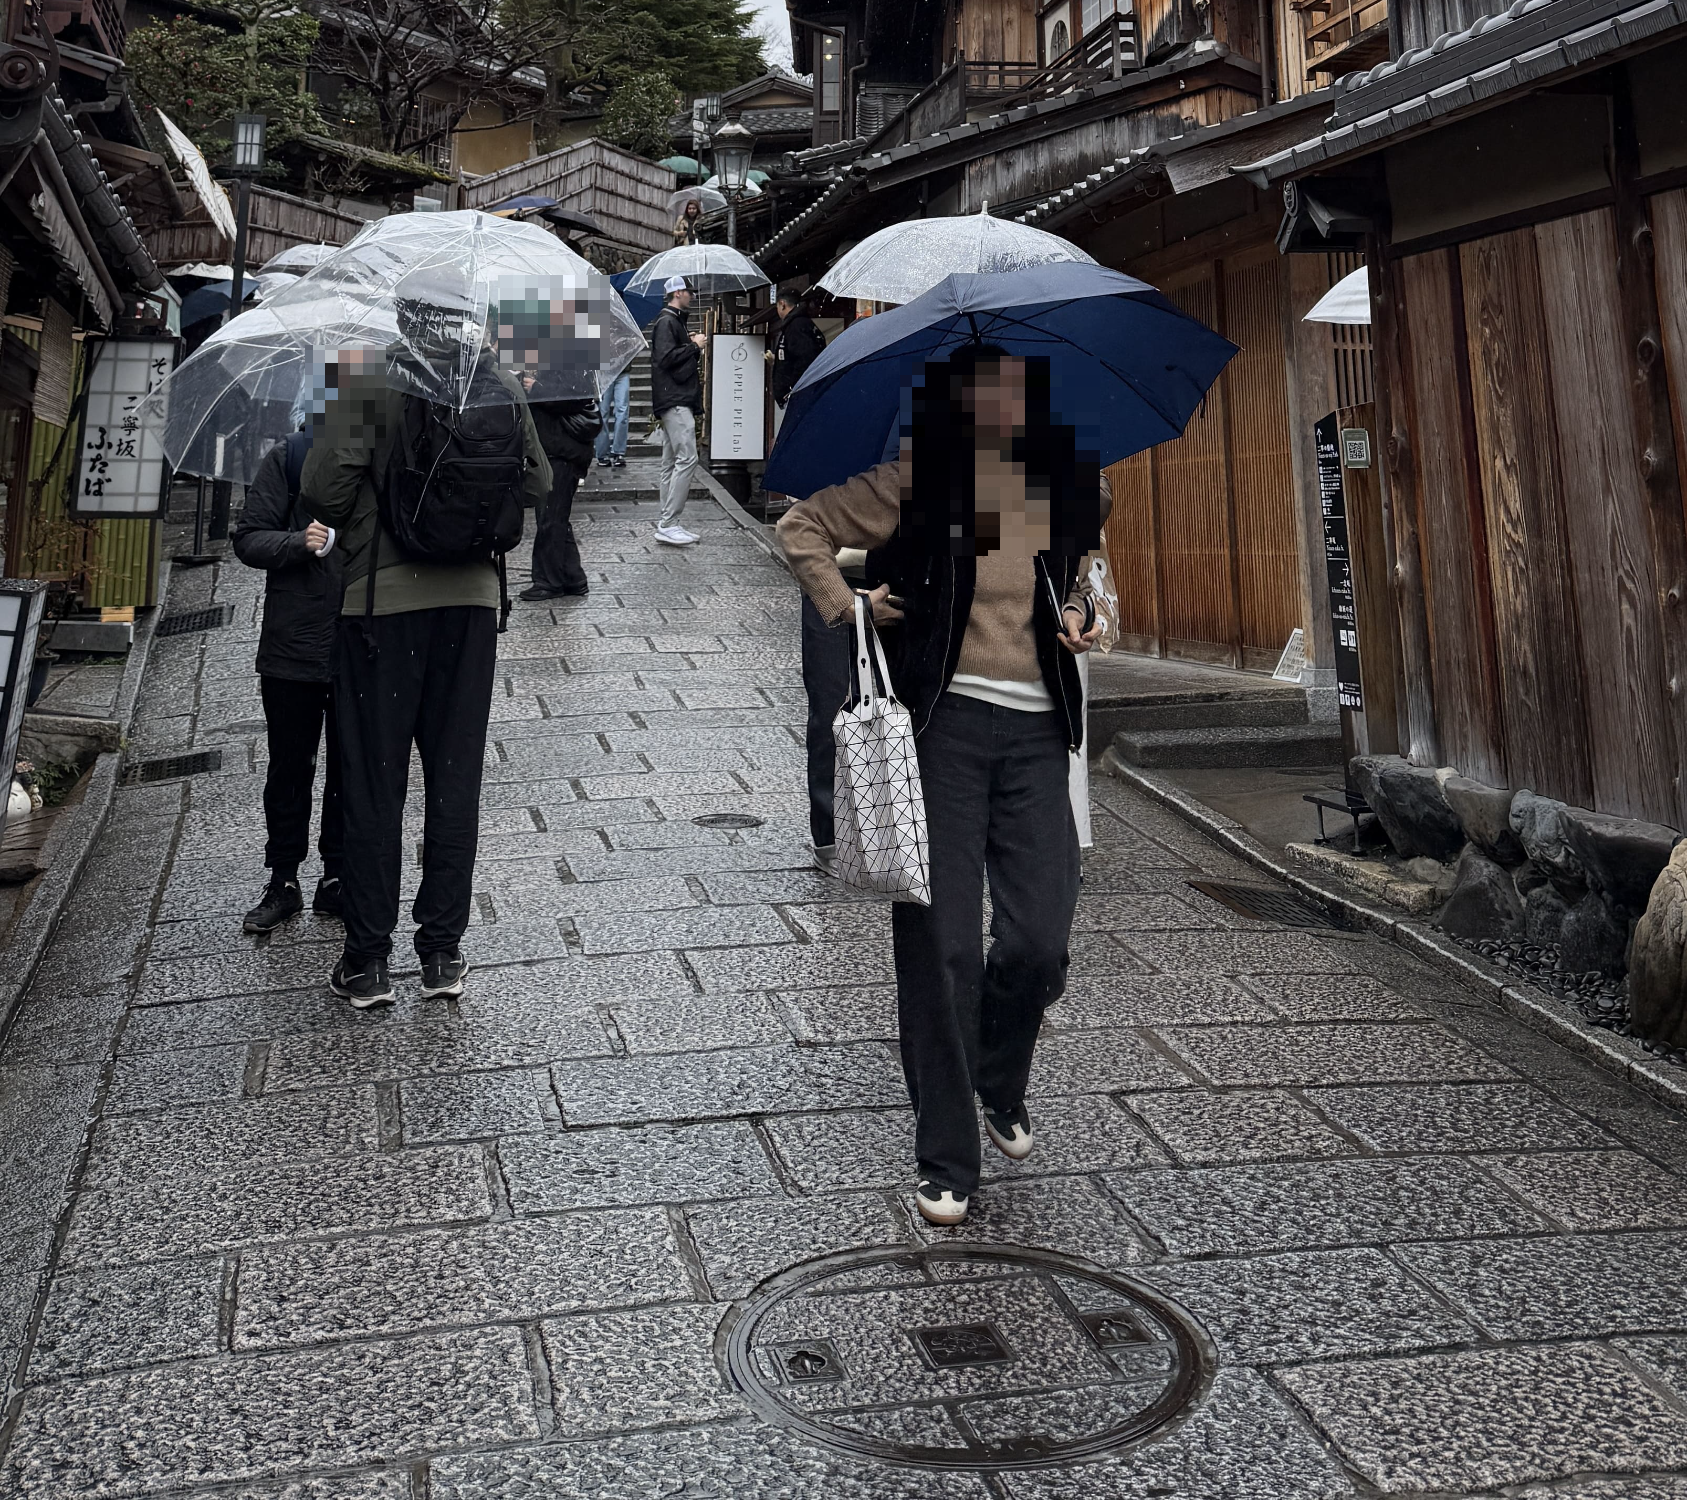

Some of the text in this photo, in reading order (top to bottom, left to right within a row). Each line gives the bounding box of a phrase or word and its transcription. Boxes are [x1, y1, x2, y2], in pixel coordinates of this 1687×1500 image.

[734, 365, 743, 402] APPLE
[733, 409, 743, 428] PIE
[84, 426, 113, 497] ふたば
